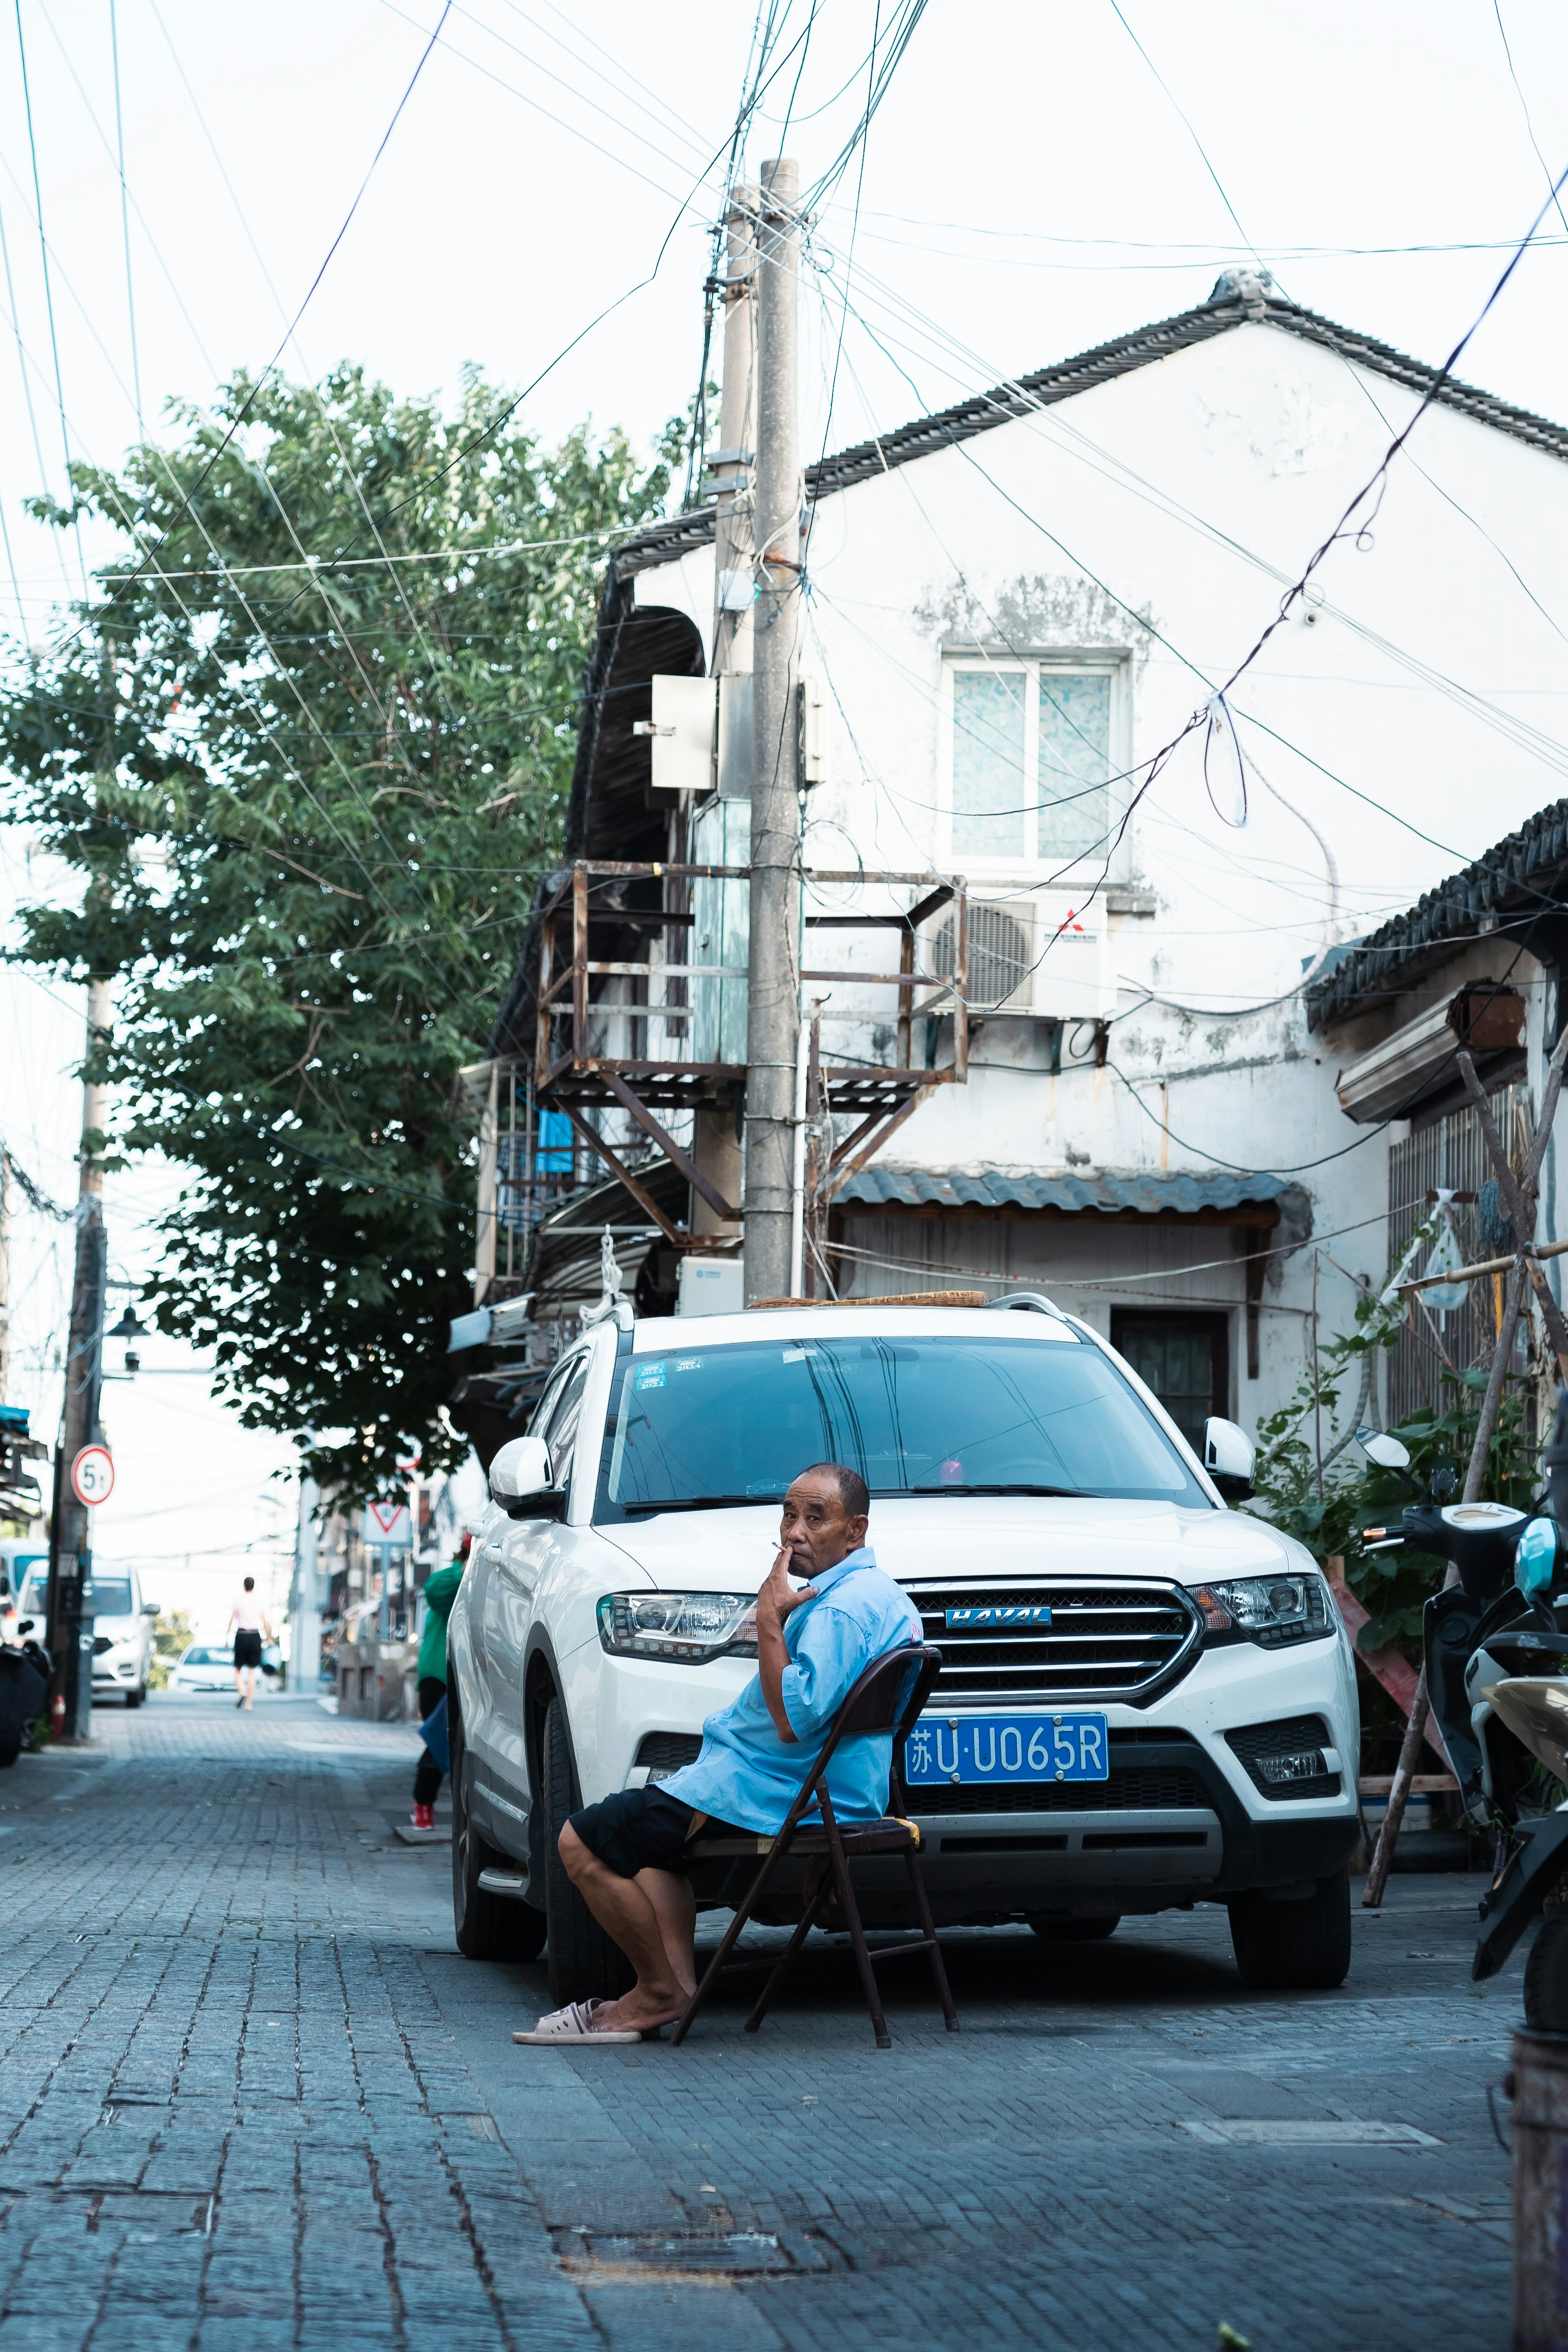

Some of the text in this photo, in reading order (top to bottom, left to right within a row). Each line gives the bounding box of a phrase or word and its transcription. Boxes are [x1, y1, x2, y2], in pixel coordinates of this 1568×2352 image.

[677, 1363, 701, 1371] 2024
[640, 1368, 663, 1377] 2022
[640, 1381, 664, 1389] 2022
[950, 1609, 1049, 1626] HAVAL
